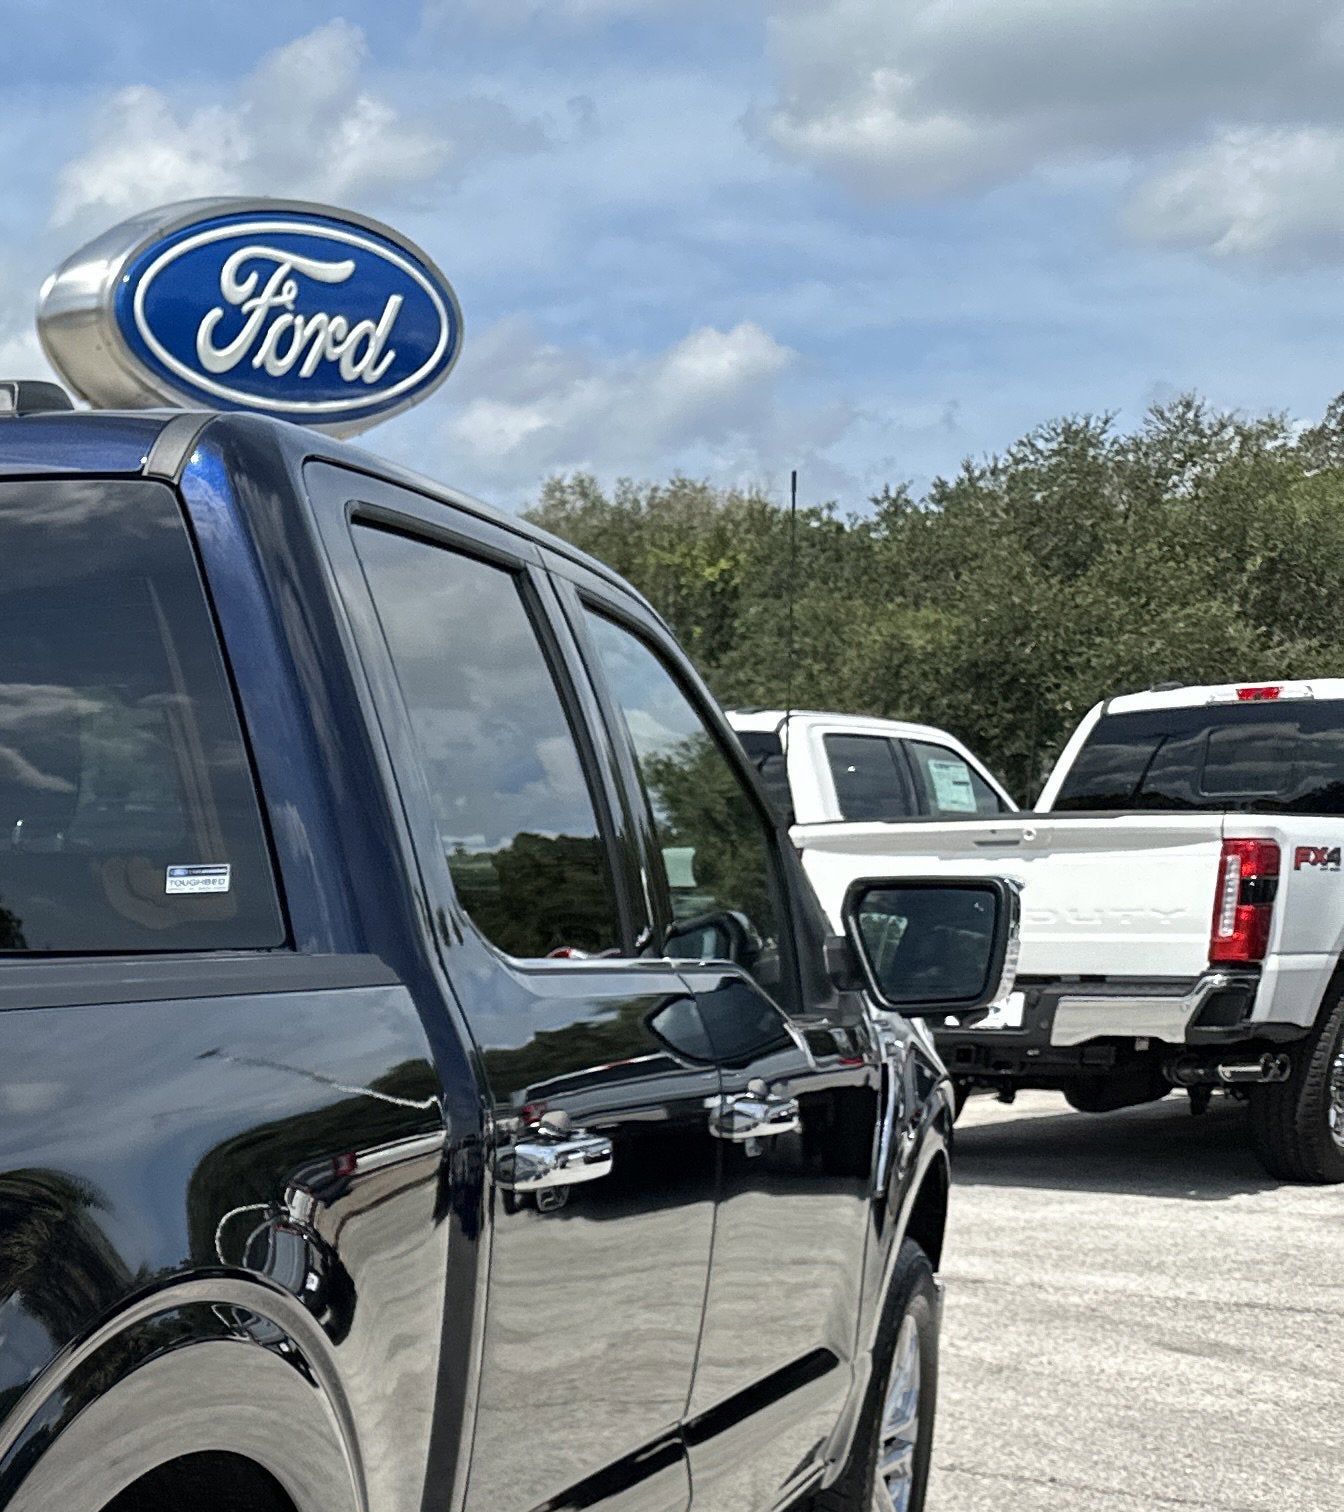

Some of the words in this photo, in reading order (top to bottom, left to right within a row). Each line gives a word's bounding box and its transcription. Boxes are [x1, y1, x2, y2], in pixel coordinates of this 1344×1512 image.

[197, 246, 405, 384] Ford
[1293, 846, 1341, 871] FX4
[1024, 907, 1189, 925] DUTY
